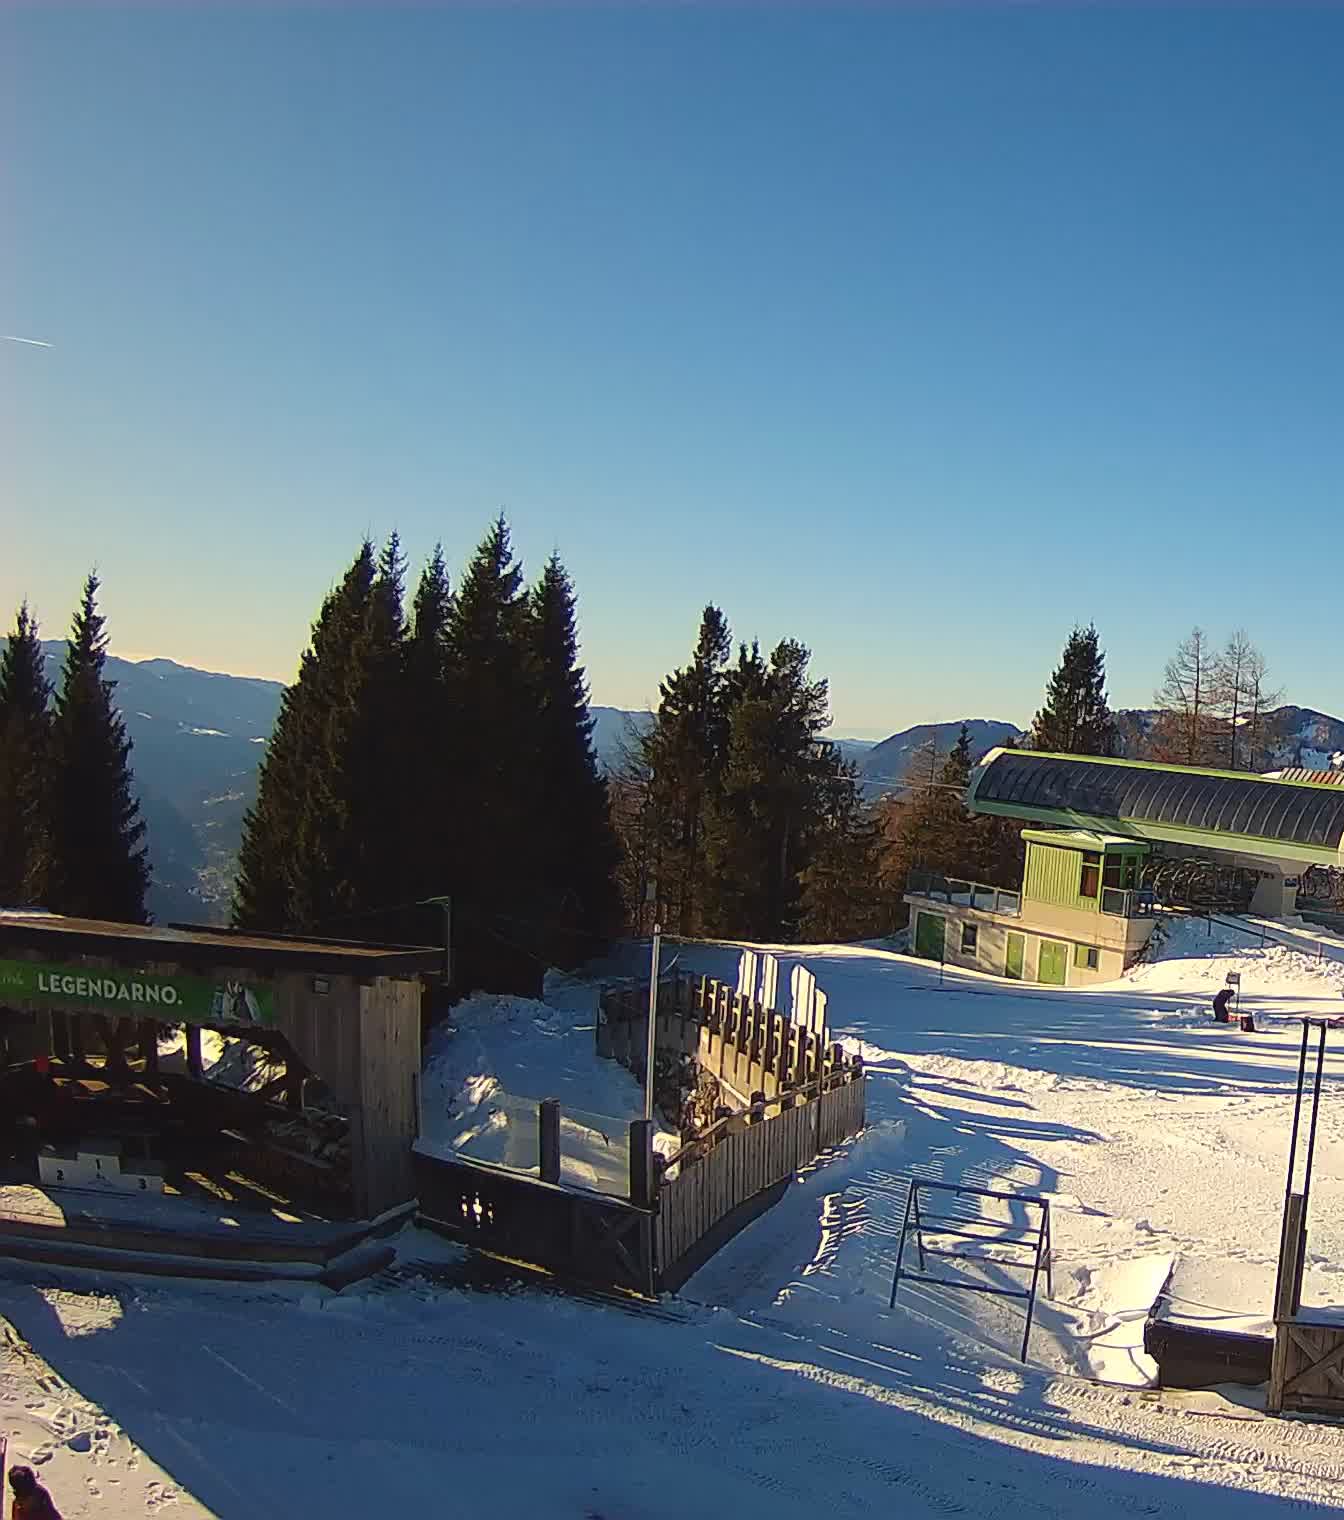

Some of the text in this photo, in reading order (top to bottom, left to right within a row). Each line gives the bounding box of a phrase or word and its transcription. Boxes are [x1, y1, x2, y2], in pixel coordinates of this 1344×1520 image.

[37, 973, 183, 1005] LEGENDARNO.
[56, 1168, 65, 1181] 2
[138, 1178, 147, 1190] 3
